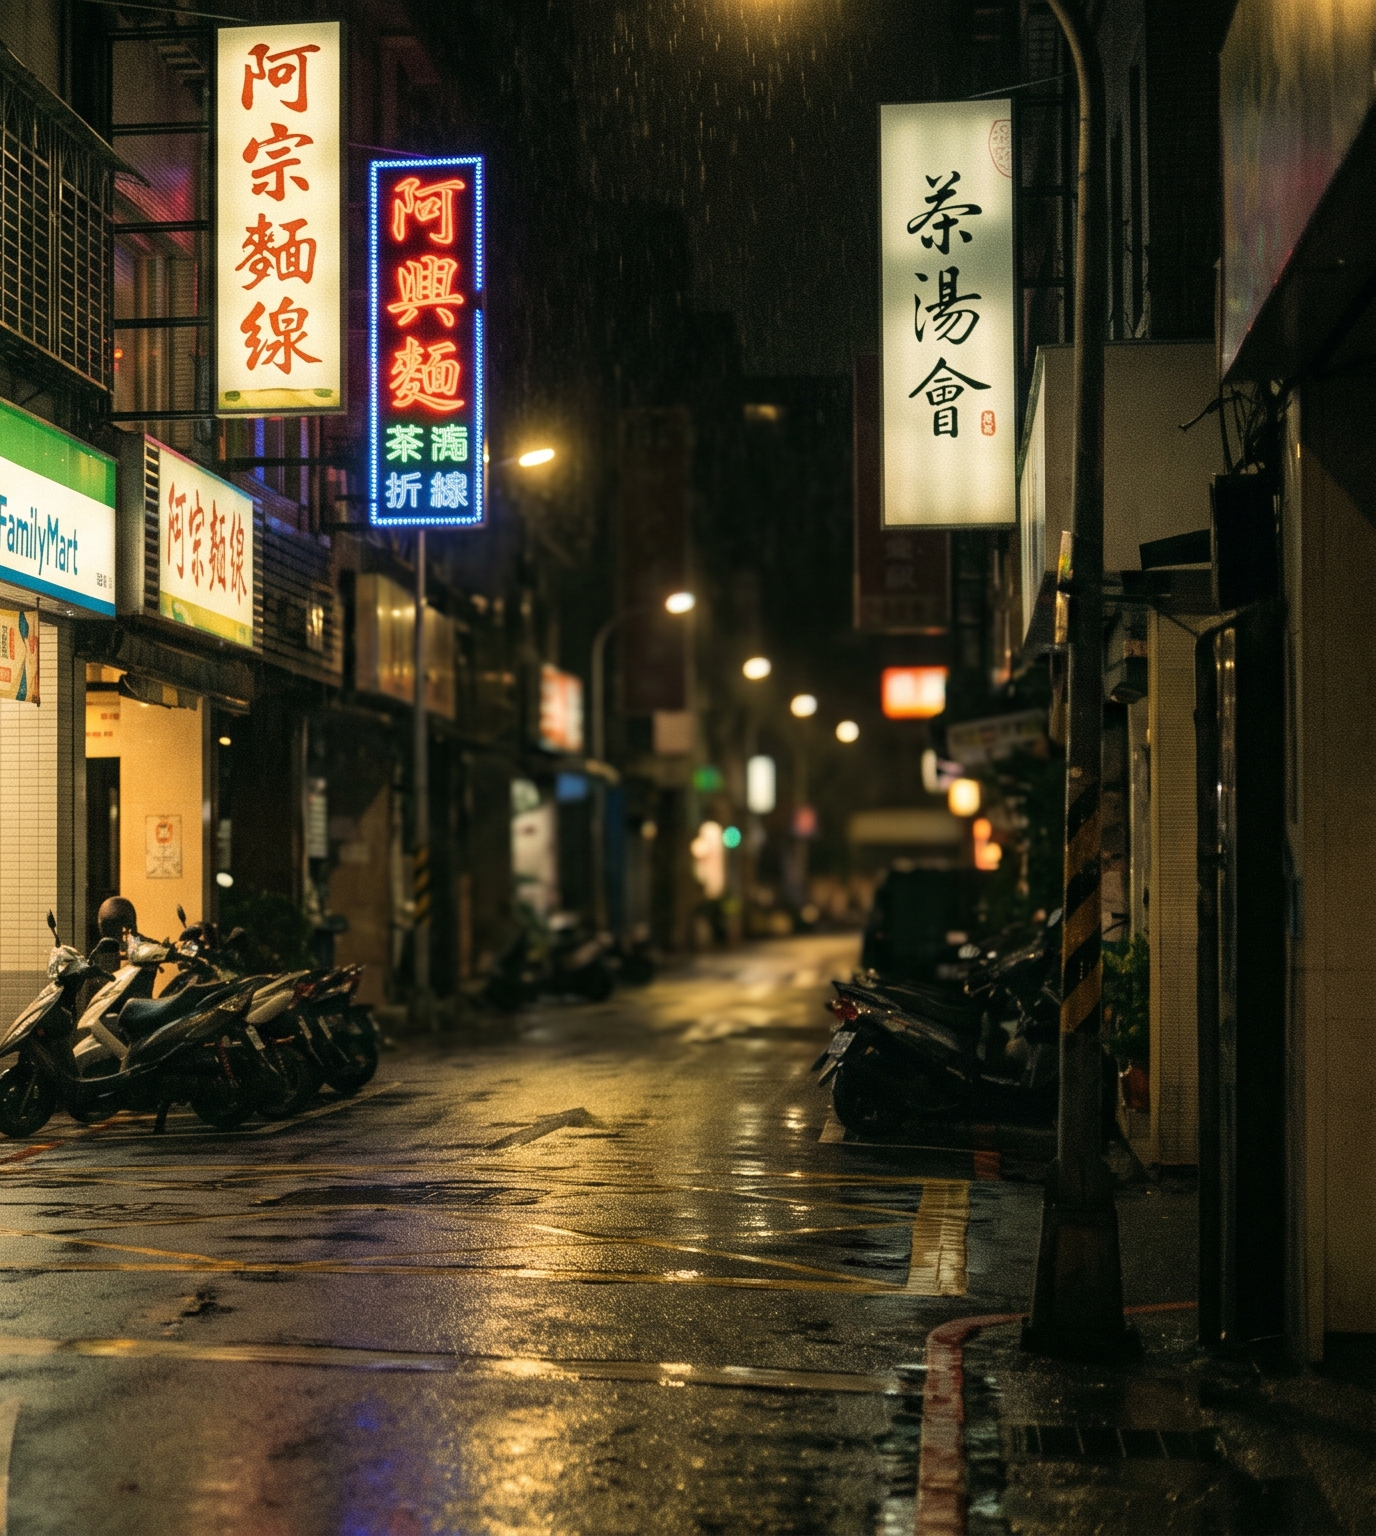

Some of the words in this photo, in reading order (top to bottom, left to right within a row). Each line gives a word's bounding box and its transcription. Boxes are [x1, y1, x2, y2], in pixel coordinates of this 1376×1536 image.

[235, 43, 322, 375] 阿宗麵線
[386, 176, 466, 413] 阿興麵
[906, 170, 992, 439] 茶湯會
[167, 482, 247, 605] 阿宗麵線
